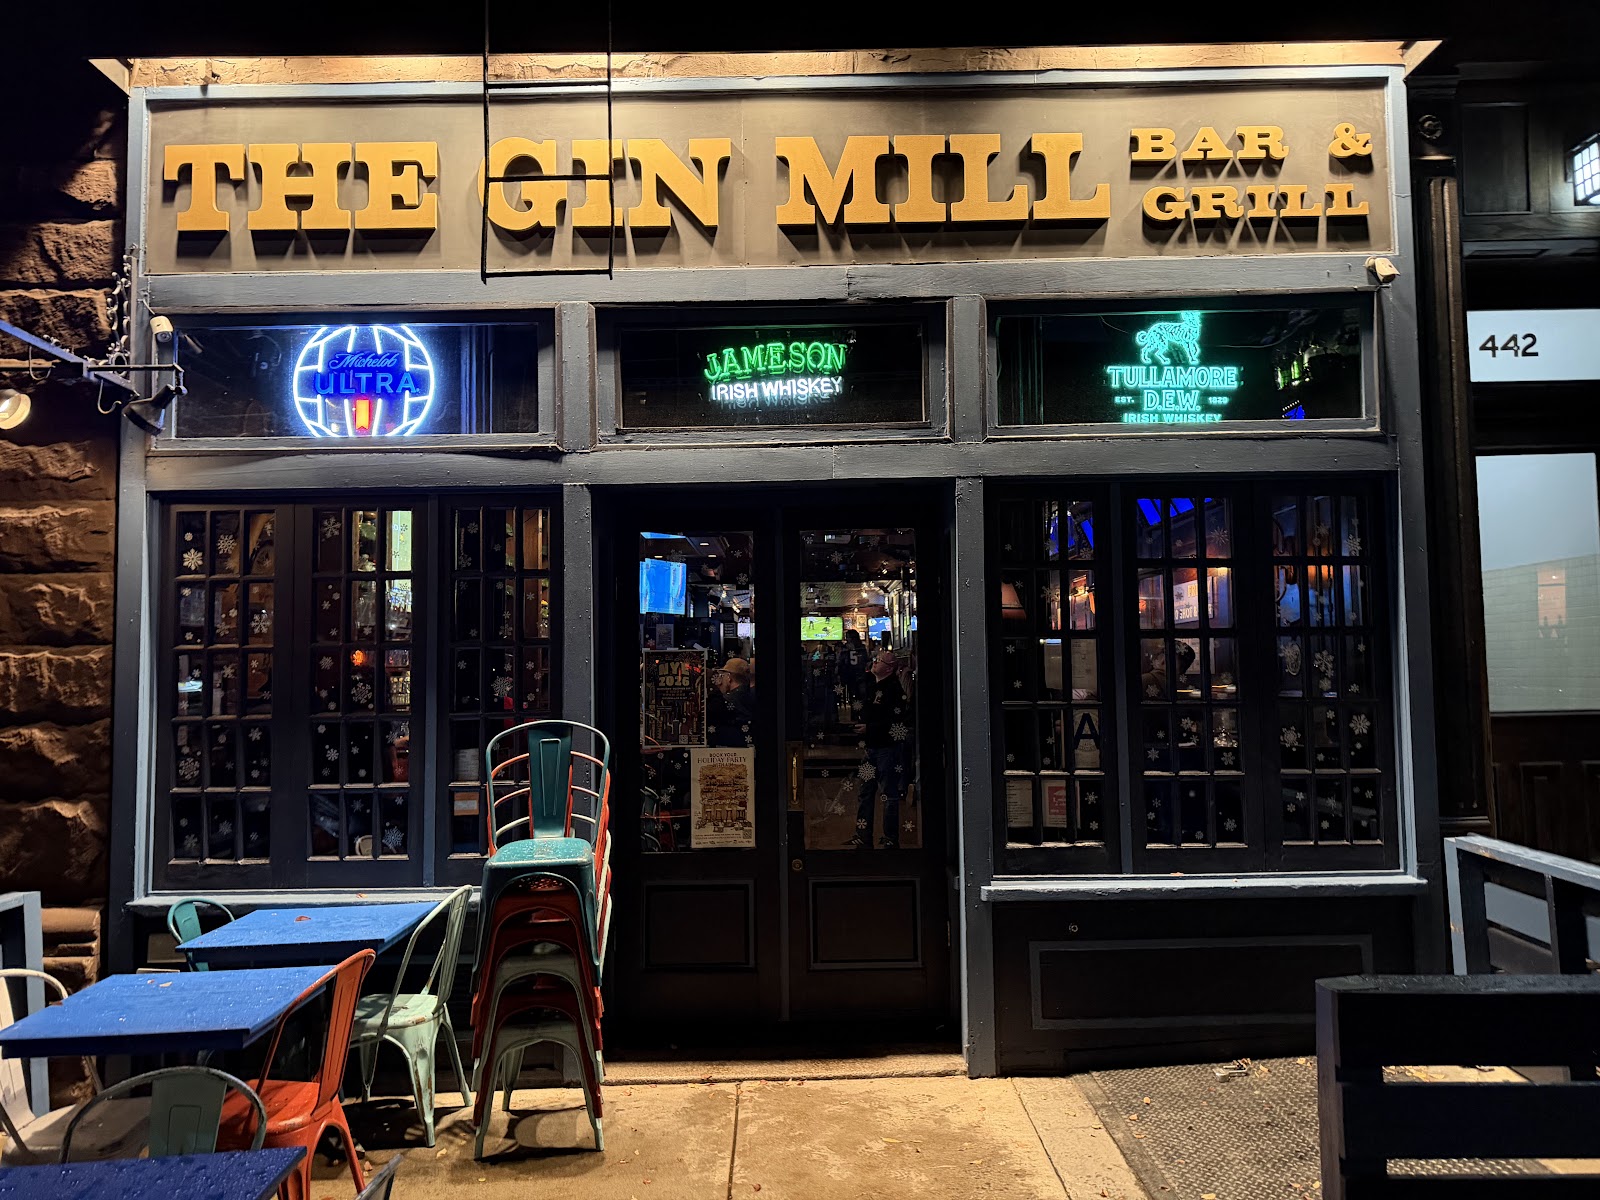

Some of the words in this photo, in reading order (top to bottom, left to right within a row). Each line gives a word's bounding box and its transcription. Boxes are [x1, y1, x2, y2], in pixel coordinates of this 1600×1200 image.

[1130, 124, 1289, 162] BAR
[1328, 122, 1373, 159] &
[164, 141, 438, 231] THE
[478, 136, 731, 231] GIN
[775, 132, 1111, 226] MILL
[1141, 183, 1370, 222] GRILL
[1479, 333, 1538, 357] 442
[329, 352, 400, 369] Michelob
[704, 341, 848, 381] JAMESON
[315, 372, 417, 395] ULTRA
[711, 381, 758, 400] IRISH
[761, 375, 843, 398] WHISKEY
[1107, 365, 1239, 389] TULLAMORE
[1114, 396, 1135, 404] EST.
[1143, 389, 1201, 411] D.E.W.
[1123, 413, 1159, 424] IRISH
[1162, 413, 1223, 424] WHISKEY
[658, 676, 690, 687] 2026
[1073, 712, 1100, 749] A
